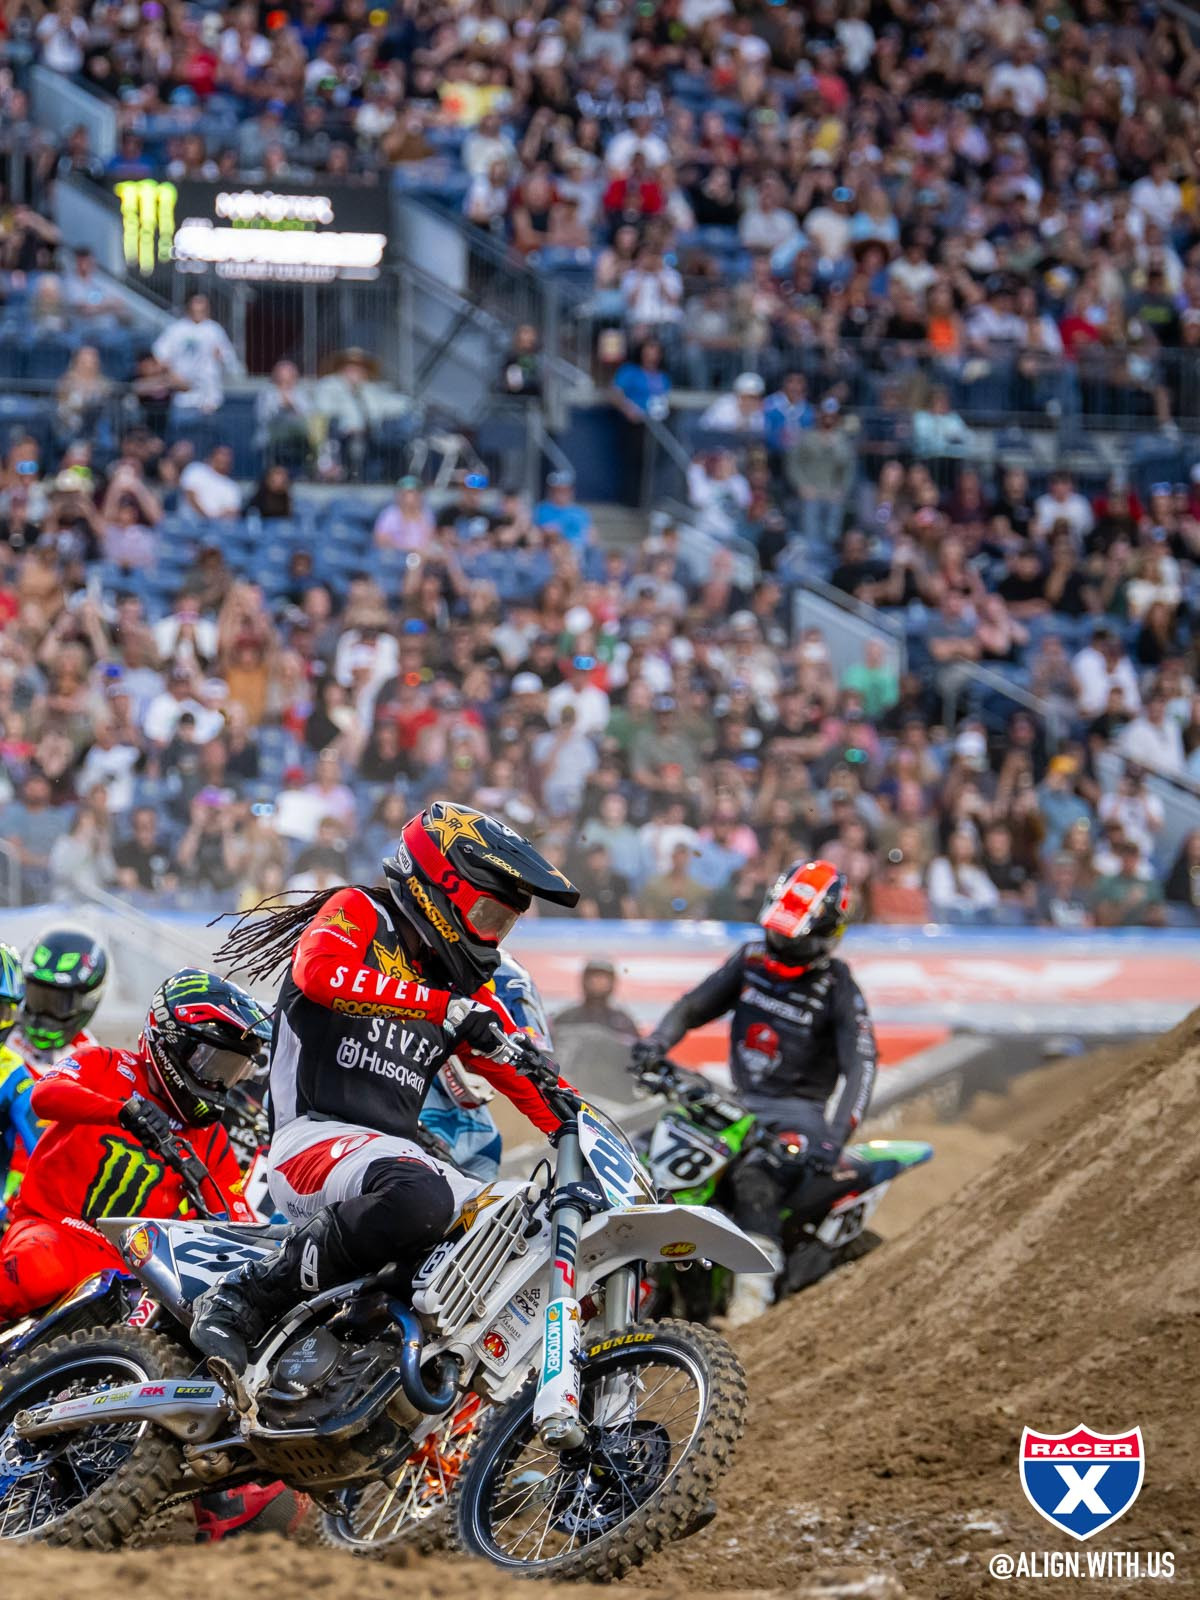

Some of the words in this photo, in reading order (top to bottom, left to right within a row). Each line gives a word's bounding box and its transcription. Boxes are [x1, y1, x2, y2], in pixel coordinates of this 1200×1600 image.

[405, 876, 461, 944] ROCKSTAR
[330, 965, 431, 1002] SEVEN
[155, 1040, 186, 1089] MONSTER
[652, 1131, 714, 1182] 78
[553, 1224, 578, 1290] WP
[547, 1321, 561, 1374] MOTOREX
[589, 1332, 656, 1357] DUNLOP
[139, 1386, 167, 1397] RK
[176, 1386, 214, 1395] EXCEL
